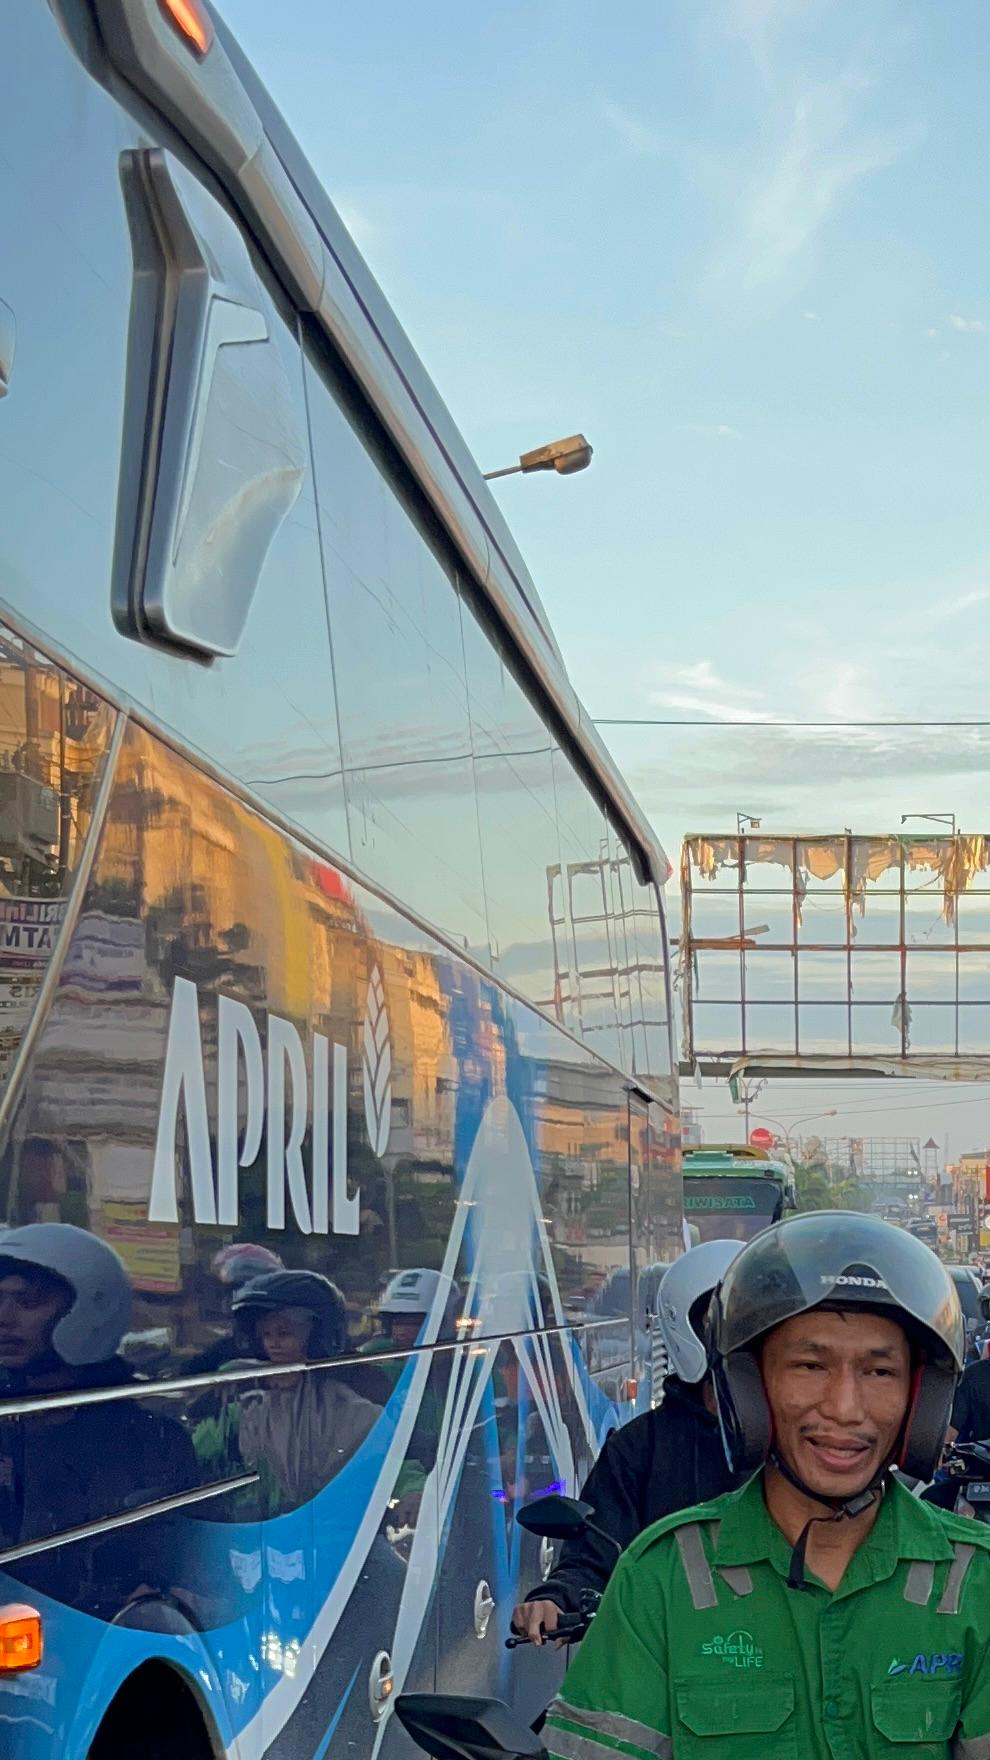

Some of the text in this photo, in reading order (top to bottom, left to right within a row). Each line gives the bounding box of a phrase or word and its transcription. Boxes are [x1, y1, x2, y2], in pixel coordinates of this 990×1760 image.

[148, 975, 360, 1235] APRIL
[820, 1275, 888, 1290] HONDA
[735, 1656, 763, 1668] LIFE
